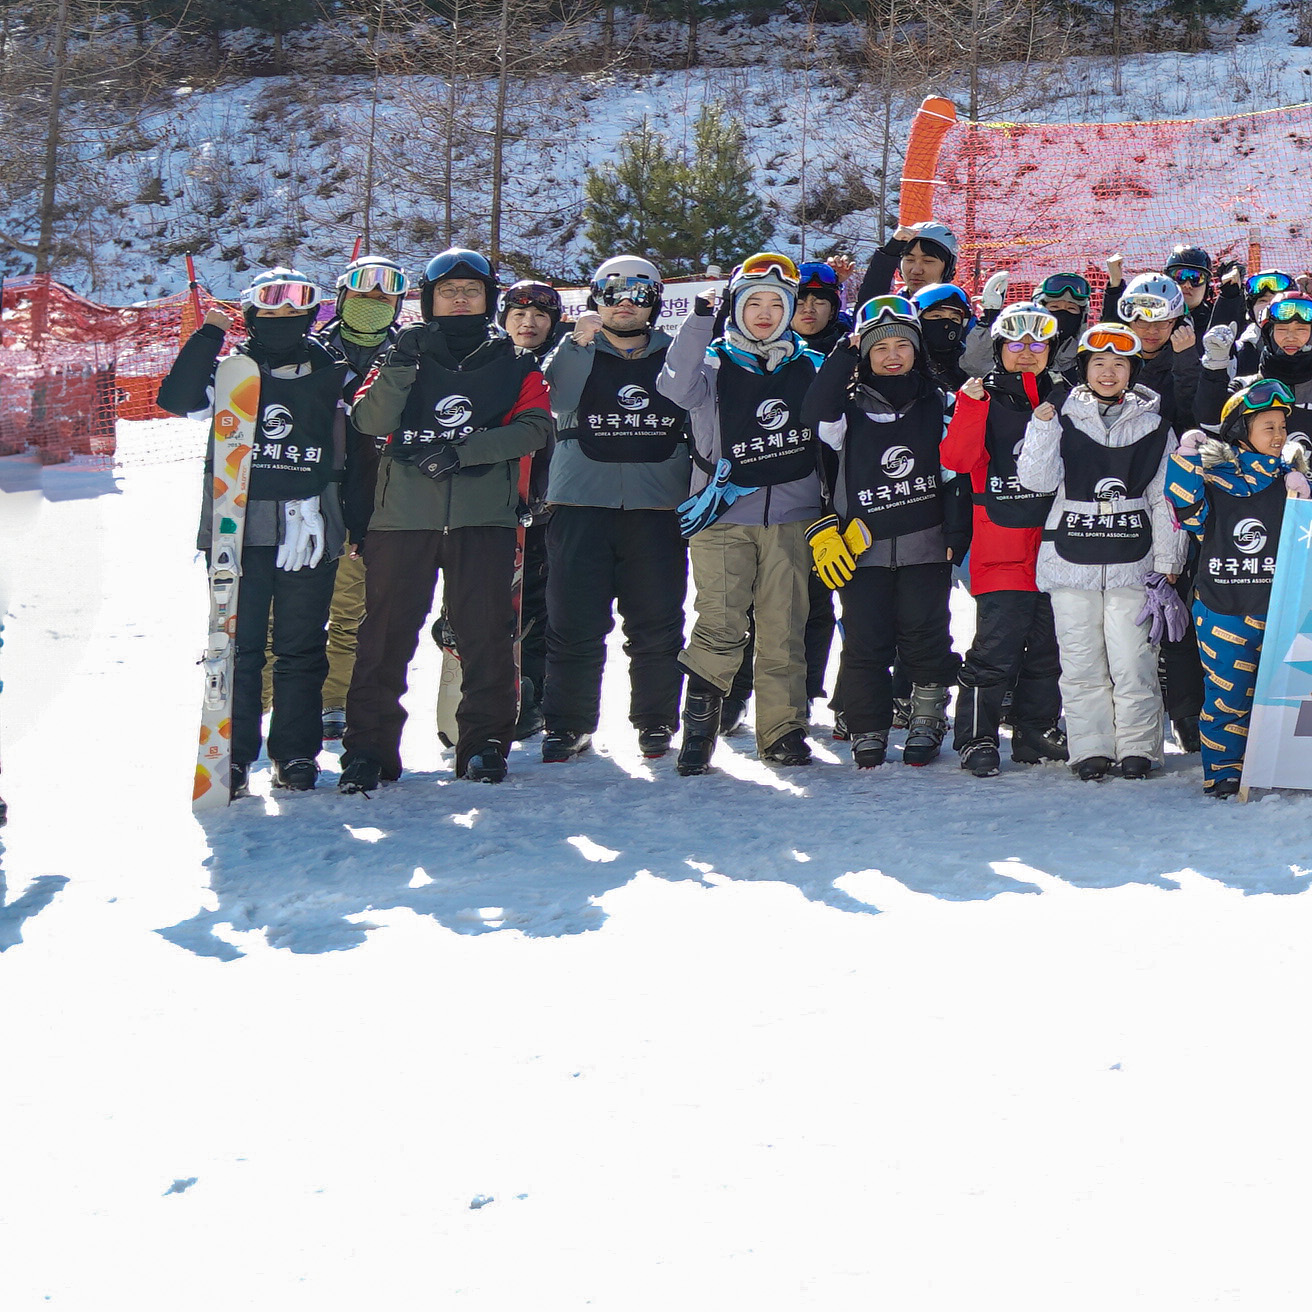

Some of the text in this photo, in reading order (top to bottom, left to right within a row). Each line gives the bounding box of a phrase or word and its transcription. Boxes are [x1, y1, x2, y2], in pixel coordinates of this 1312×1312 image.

[587, 413, 676, 429] 한국체육회
[731, 428, 813, 459] 한국체육회
[252, 442, 322, 464] 국체육회
[740, 455, 757, 465] KOREA
[758, 452, 778, 461] SPORTS
[272, 464, 312, 472] ASSOCIATION
[857, 474, 938, 507] 한국체육회
[867, 504, 885, 514] KOREA
[885, 500, 906, 510] SPORTS
[1208, 557, 1276, 576] 한국체육
